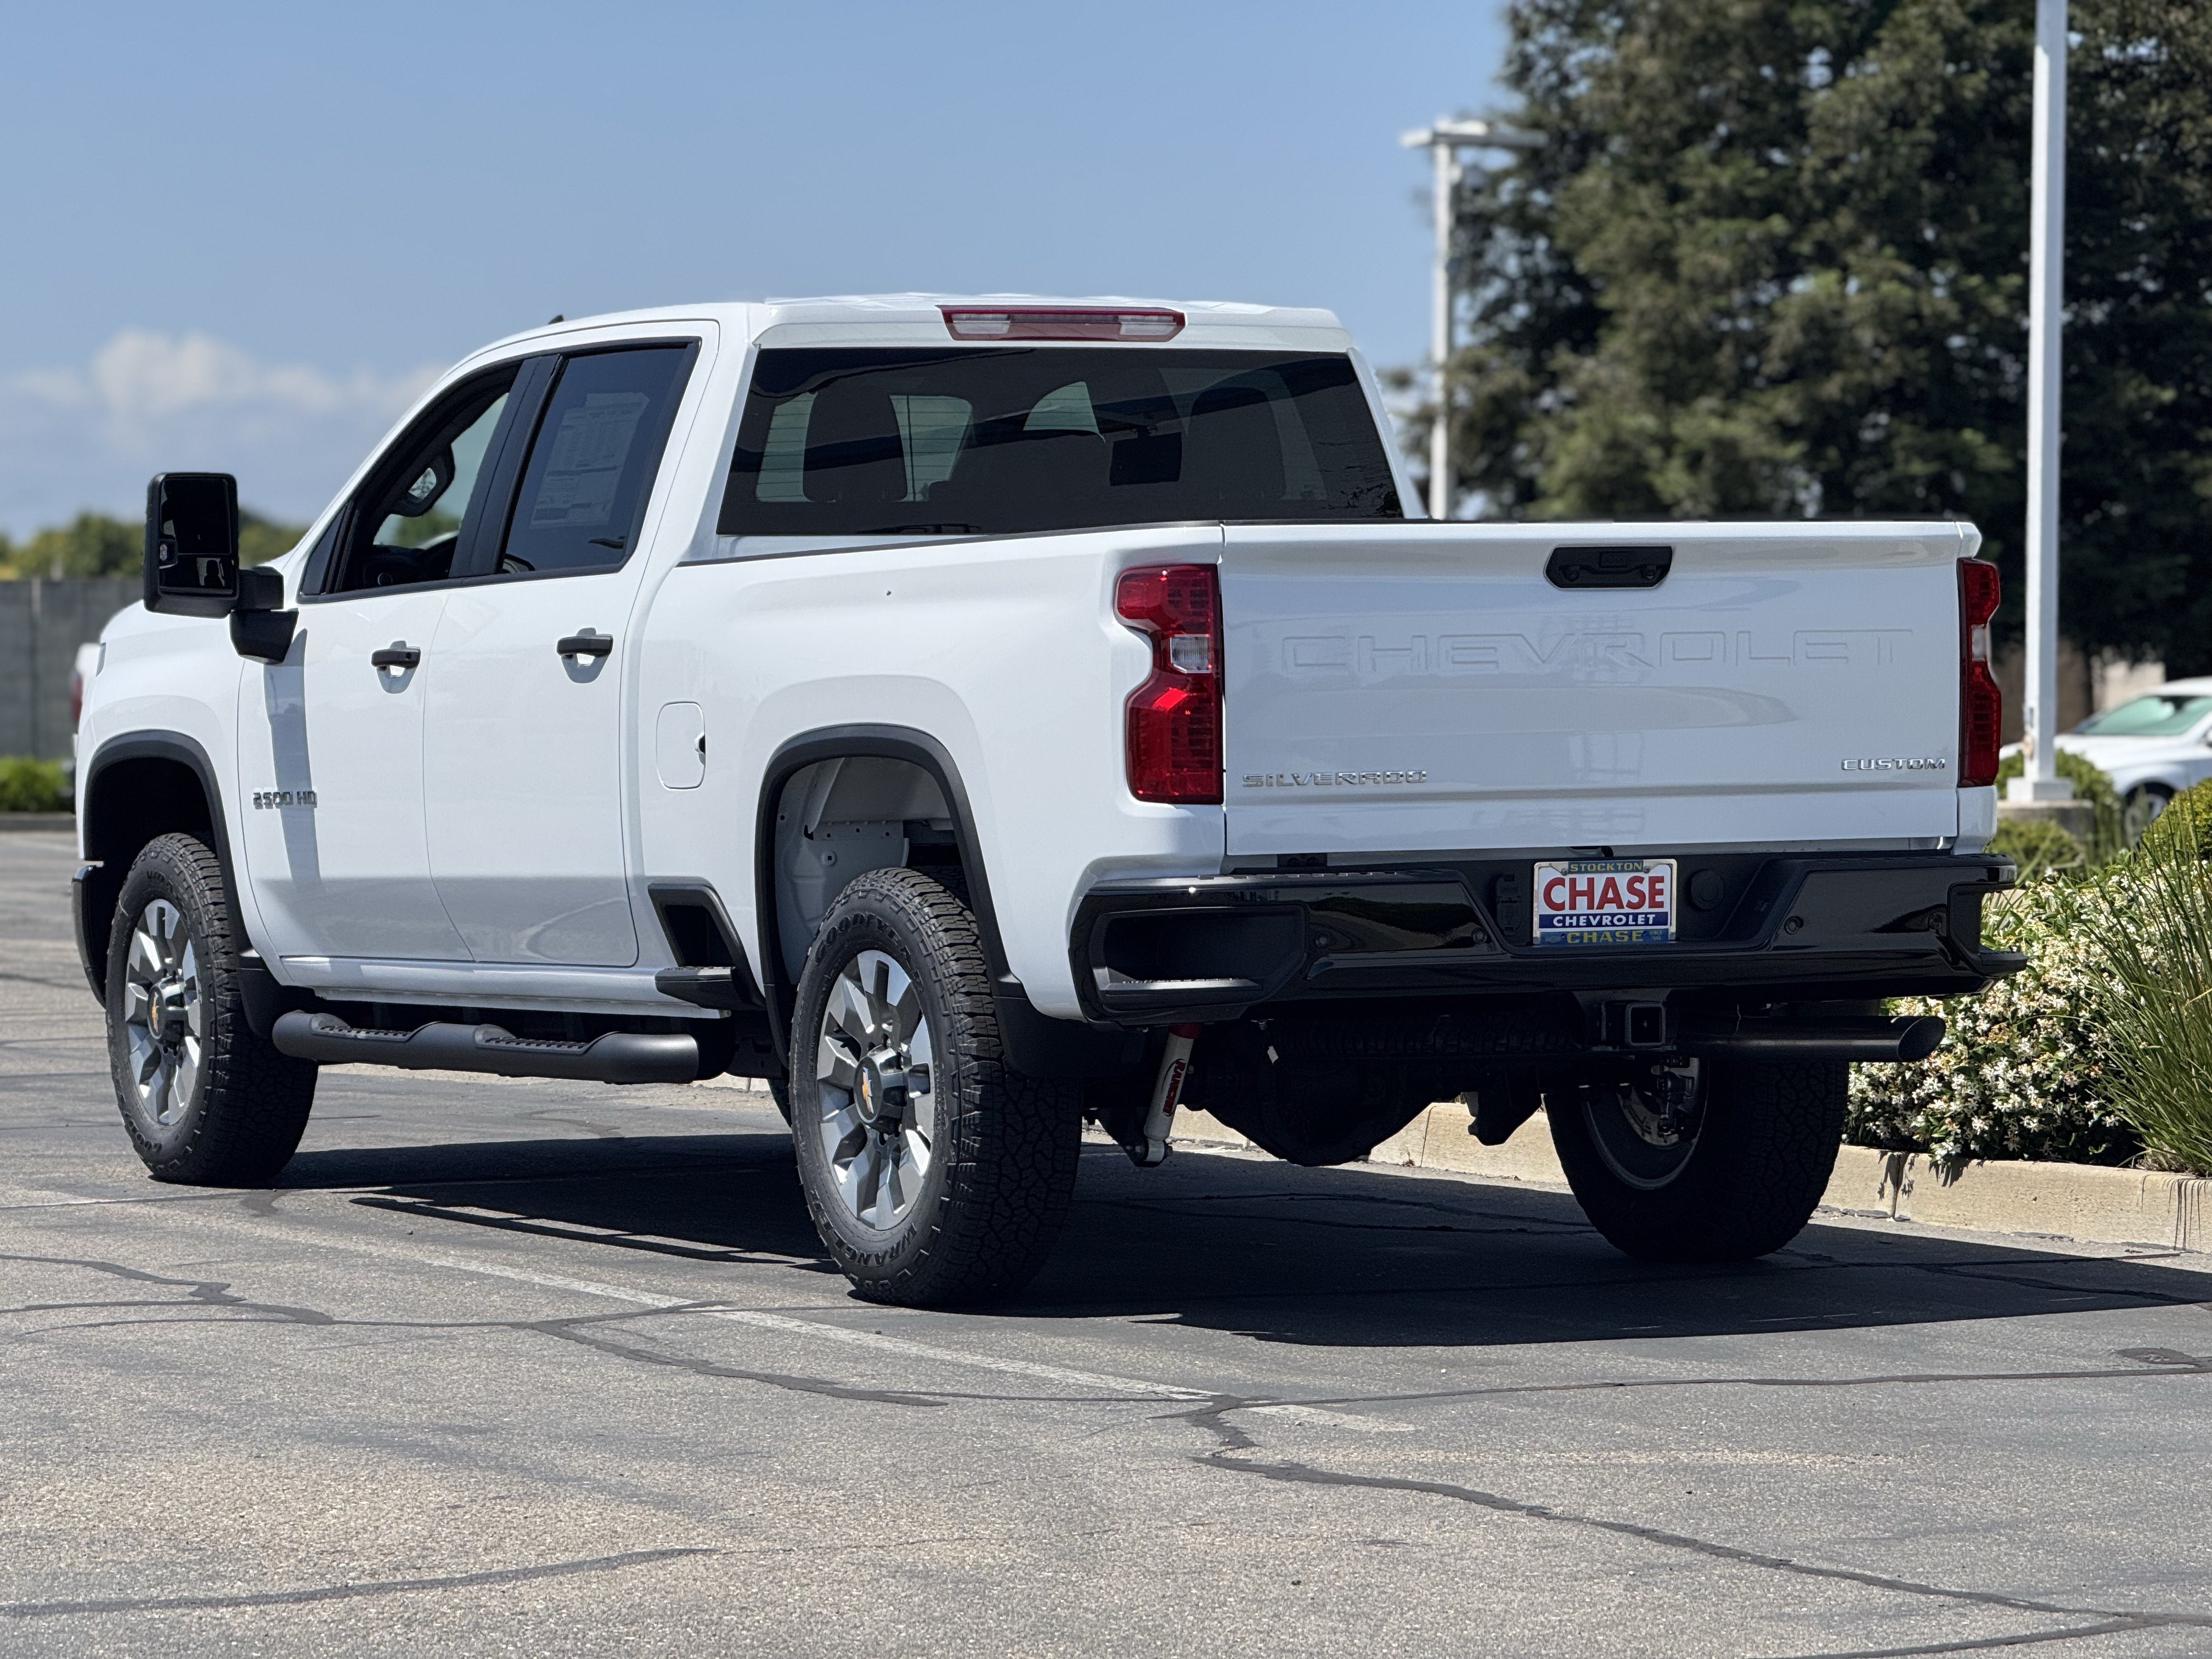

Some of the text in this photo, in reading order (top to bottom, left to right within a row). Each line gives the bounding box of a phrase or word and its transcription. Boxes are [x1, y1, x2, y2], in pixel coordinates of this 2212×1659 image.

[1282, 629, 1913, 673] CHEVROLET
[1841, 758, 1945, 770] CUSTOM
[1243, 770, 1426, 787] SILVERADO
[253, 791, 317, 808] 2500 HD
[1570, 861, 1642, 872] STOCKTON
[1543, 875, 1664, 911] CHASE
[1553, 914, 1656, 927] CHEVROLET
[1567, 930, 1644, 944] CHASE
[815, 912, 924, 992] GOODYEAR
[811, 1188, 918, 1267] WRANGLER
